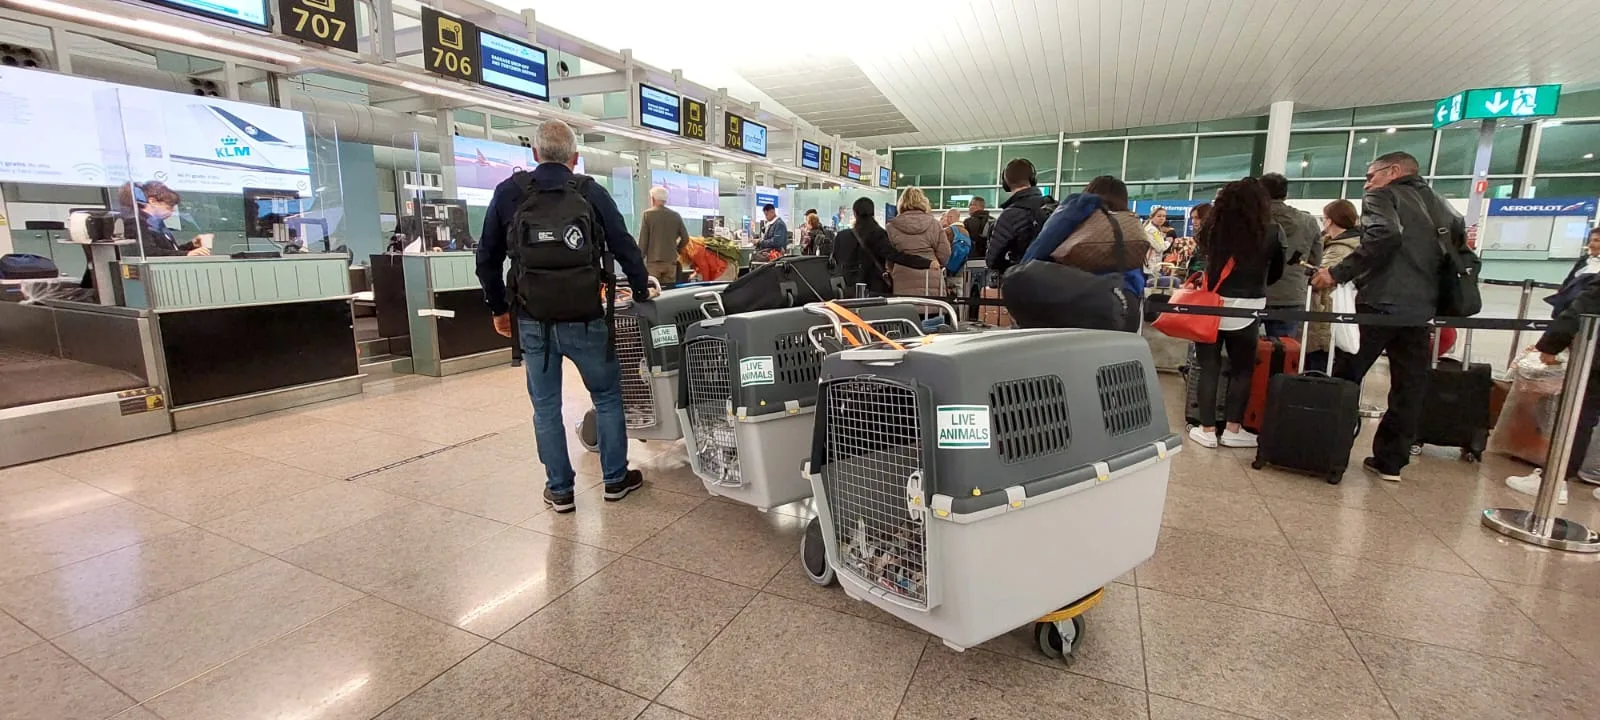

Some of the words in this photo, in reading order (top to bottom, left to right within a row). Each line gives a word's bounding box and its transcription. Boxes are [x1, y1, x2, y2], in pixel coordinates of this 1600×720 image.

[292, 7, 346, 42] 707
[431, 46, 472, 76] 706
[687, 122, 703, 137] 705
[727, 133, 741, 147] 704
[215, 146, 250, 158] KLM
[658, 328, 670, 336] LIVE
[654, 335, 678, 344] ANIMALS
[746, 361, 763, 371] LIVE
[741, 370, 773, 380] ANIMALS
[951, 413, 977, 426] LIVE
[940, 428, 989, 440] ANIMALS
